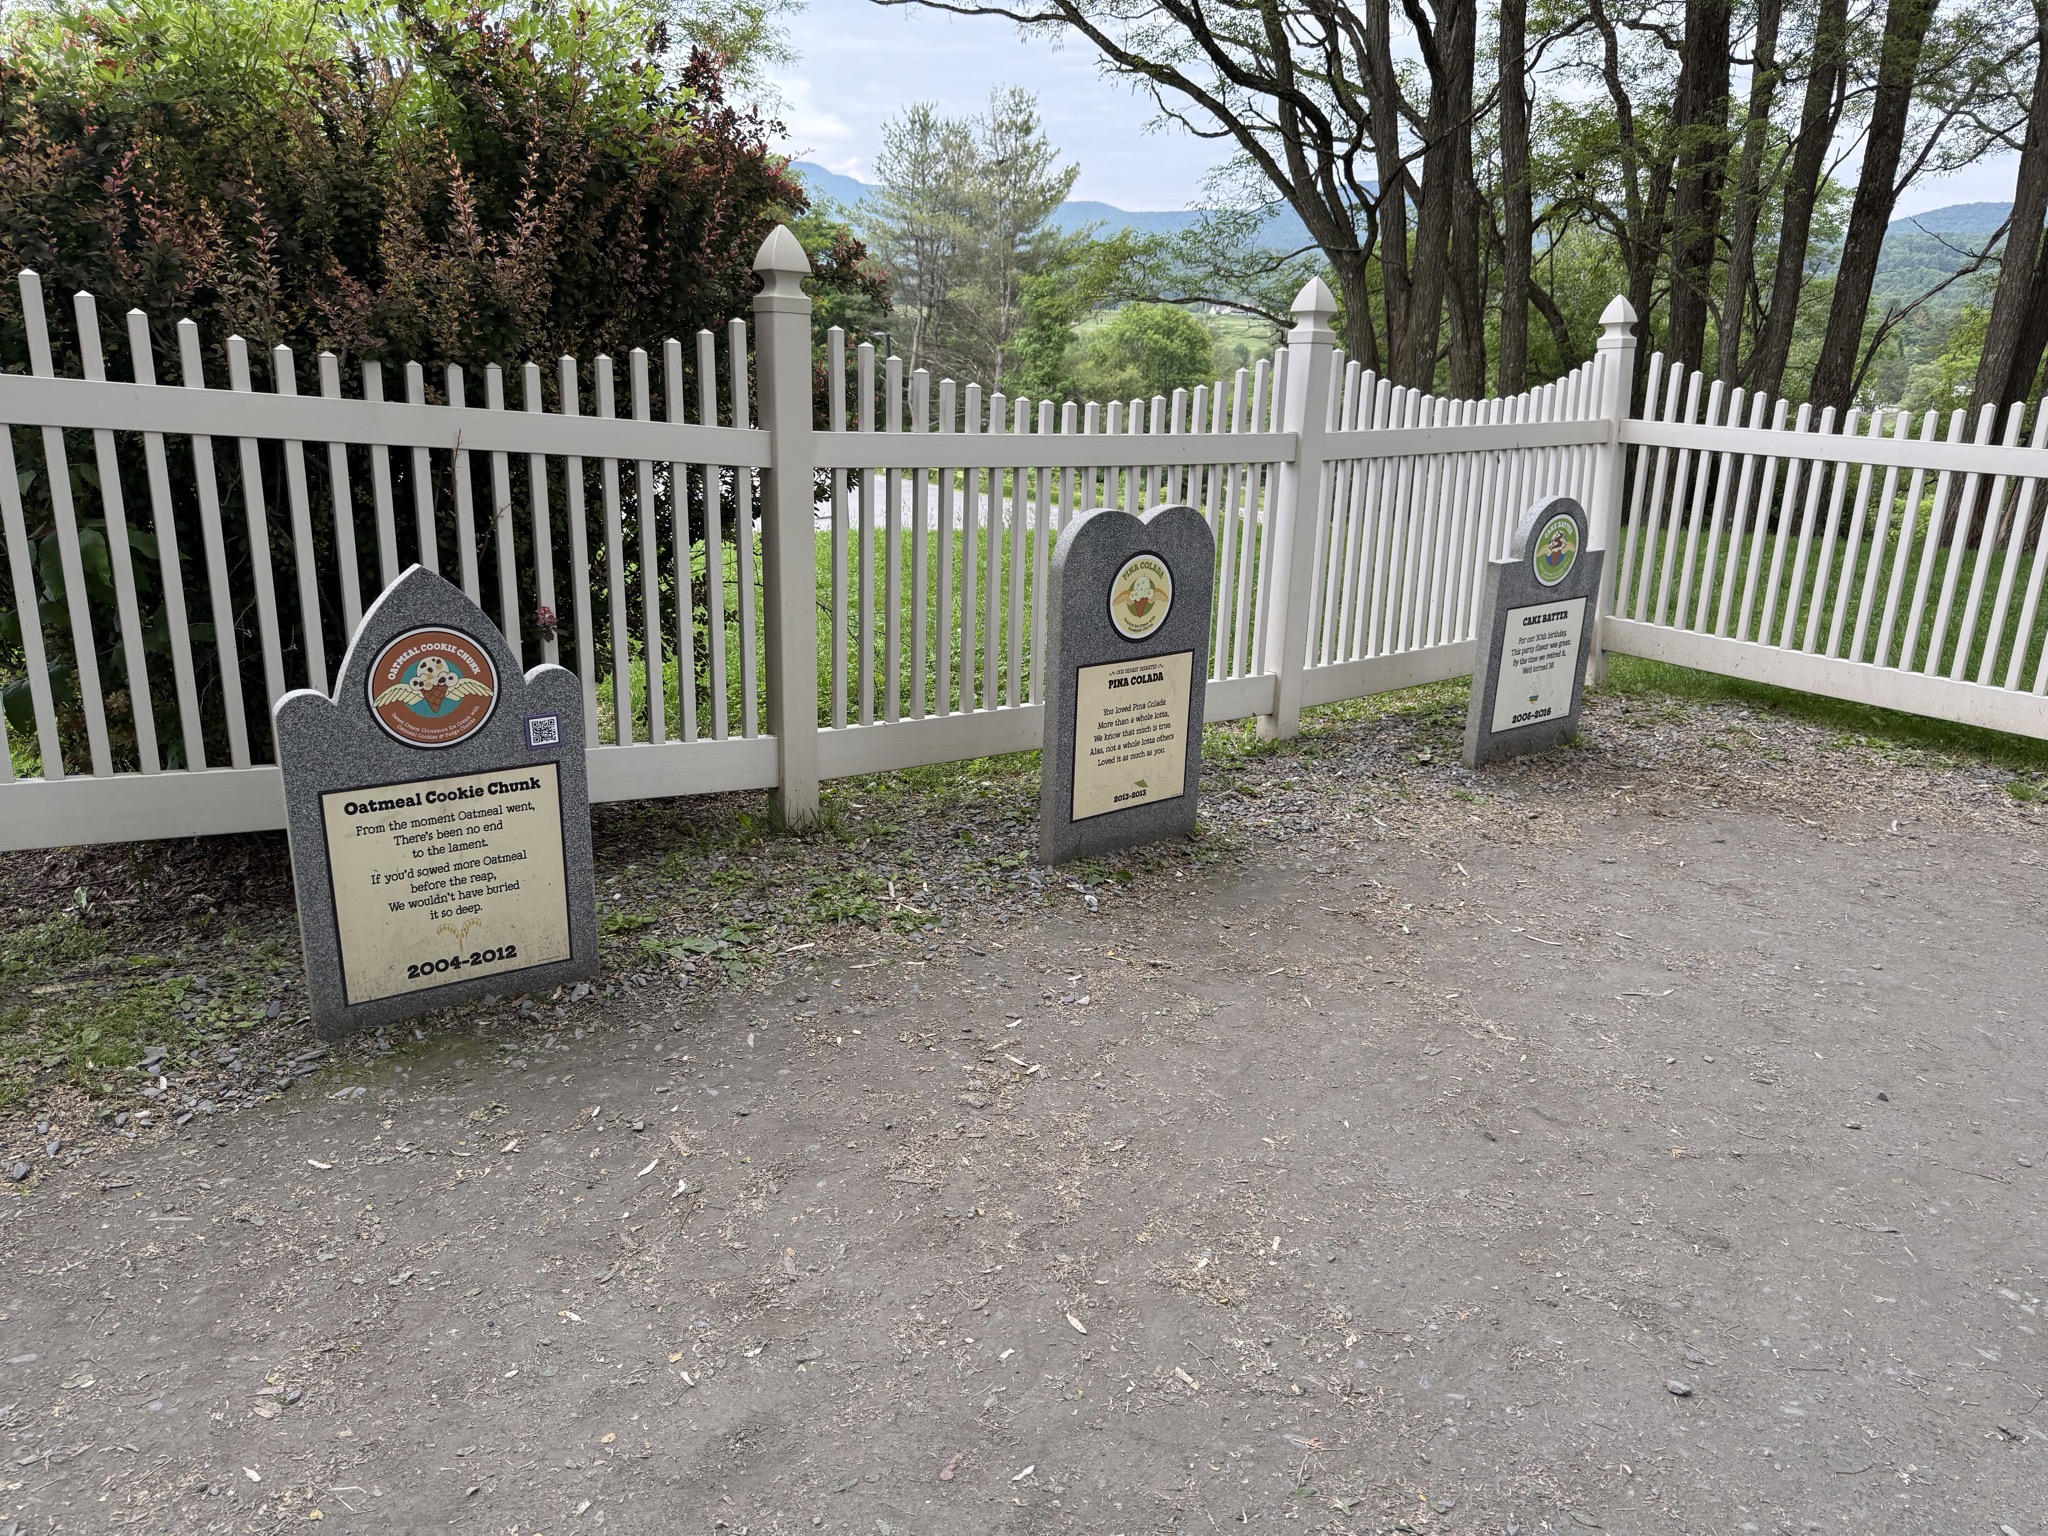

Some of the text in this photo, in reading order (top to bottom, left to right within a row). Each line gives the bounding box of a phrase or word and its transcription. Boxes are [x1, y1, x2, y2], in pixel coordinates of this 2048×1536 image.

[1140, 562, 1164, 579] COLADA
[1523, 611, 1568, 626] CAKE BATTER
[1521, 646, 1535, 655] party
[1546, 650, 1561, 659] retired
[388, 643, 481, 680] OATMEAL COOKIE CHUNK
[1533, 663, 1548, 672] turned
[1108, 672, 1163, 689] PINA COLADA
[1116, 705, 1131, 713] loved
[1147, 699, 1166, 708] Colada
[391, 713, 404, 724] Sweet
[404, 723, 420, 731] Cream
[457, 716, 471, 726] Cream
[1115, 718, 1129, 726] than
[1136, 714, 1153, 722] whole
[1512, 707, 1551, 723] 2008-2016
[397, 725, 417, 737] Oatmeal
[1104, 732, 1121, 741] know
[1136, 726, 1151, 735] much
[1090, 748, 1104, 756] Alas,
[1123, 740, 1140, 749] whole
[1141, 738, 1155, 746] lotta
[1156, 733, 1174, 743] others
[1098, 756, 1115, 767] Loved
[1130, 751, 1145, 760] much
[1154, 747, 1165, 756] you.
[344, 777, 541, 816] Oatmeal Cookie Chunk
[1114, 790, 1146, 802] 2013-2013
[356, 801, 535, 836] From the moment Oatmeal went,
[394, 821, 503, 846] There's been no end
[412, 838, 489, 858] to the lament.
[371, 851, 527, 885] If you'd sowed more Oatmeal
[410, 872, 497, 894] before the reap,
[388, 881, 520, 912] We wouldn't have buried
[430, 903, 483, 920] it so deep.
[407, 945, 517, 979] 2004-2012
